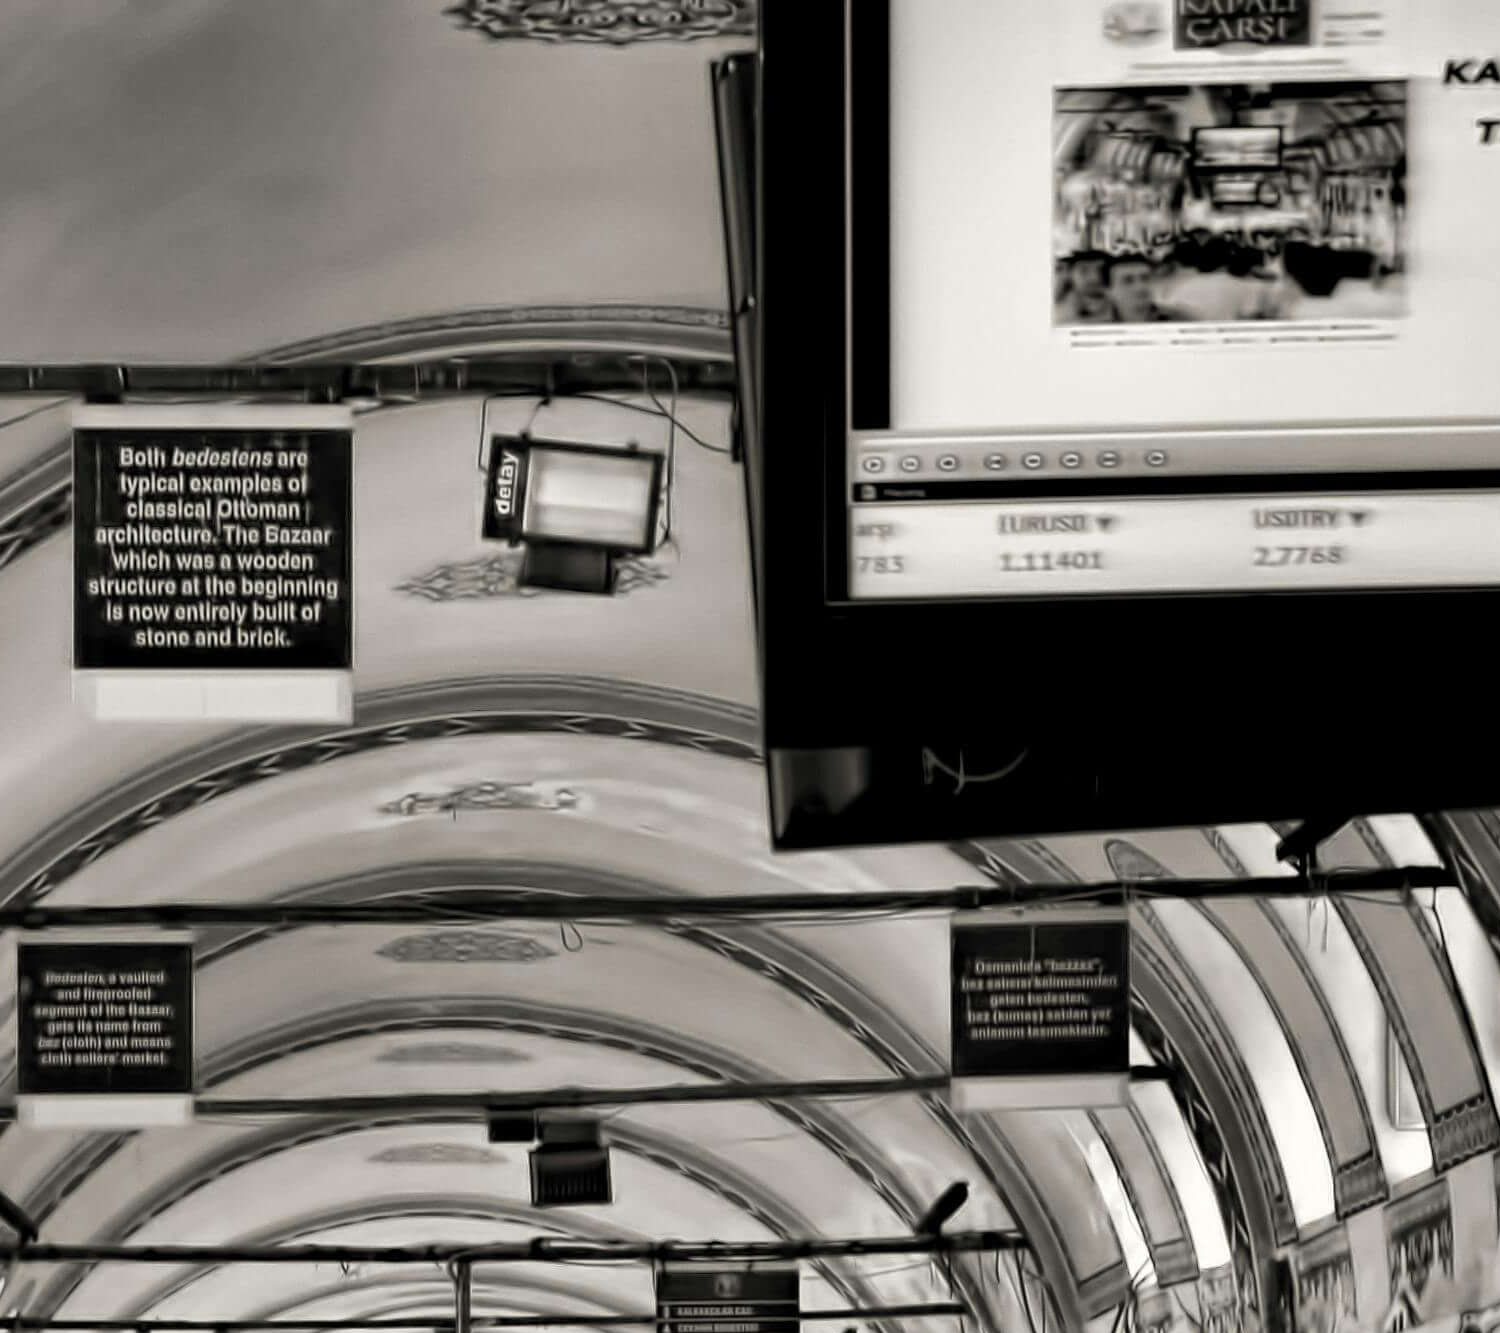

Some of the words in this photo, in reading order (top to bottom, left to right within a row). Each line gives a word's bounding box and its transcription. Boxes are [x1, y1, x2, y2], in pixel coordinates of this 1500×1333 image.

[119, 447, 166, 468] Both
[172, 447, 273, 468] bedestens
[278, 453, 308, 468] are
[120, 473, 184, 497] typical
[190, 473, 282, 497] examples
[288, 473, 308, 493] of
[127, 499, 211, 519] classical
[217, 499, 300, 519] Ottoman
[1253, 509, 1339, 529] USDTRY
[96, 526, 218, 545] architecture.
[223, 525, 259, 545] The
[265, 525, 331, 545] Bazaar
[114, 550, 170, 570] which
[177, 555, 214, 570] was
[220, 555, 231, 570] a
[237, 551, 313, 571] wooden
[89, 575, 176, 596] structure
[182, 577, 199, 596] at
[205, 576, 236, 596] the
[242, 576, 339, 600] beginning
[107, 603, 122, 622] is
[129, 606, 170, 622] now
[175, 602, 247, 627] entirely
[253, 602, 295, 622] built
[301, 602, 321, 622] of
[136, 628, 190, 647] stone
[195, 627, 231, 647] and
[237, 627, 292, 647] brick.
